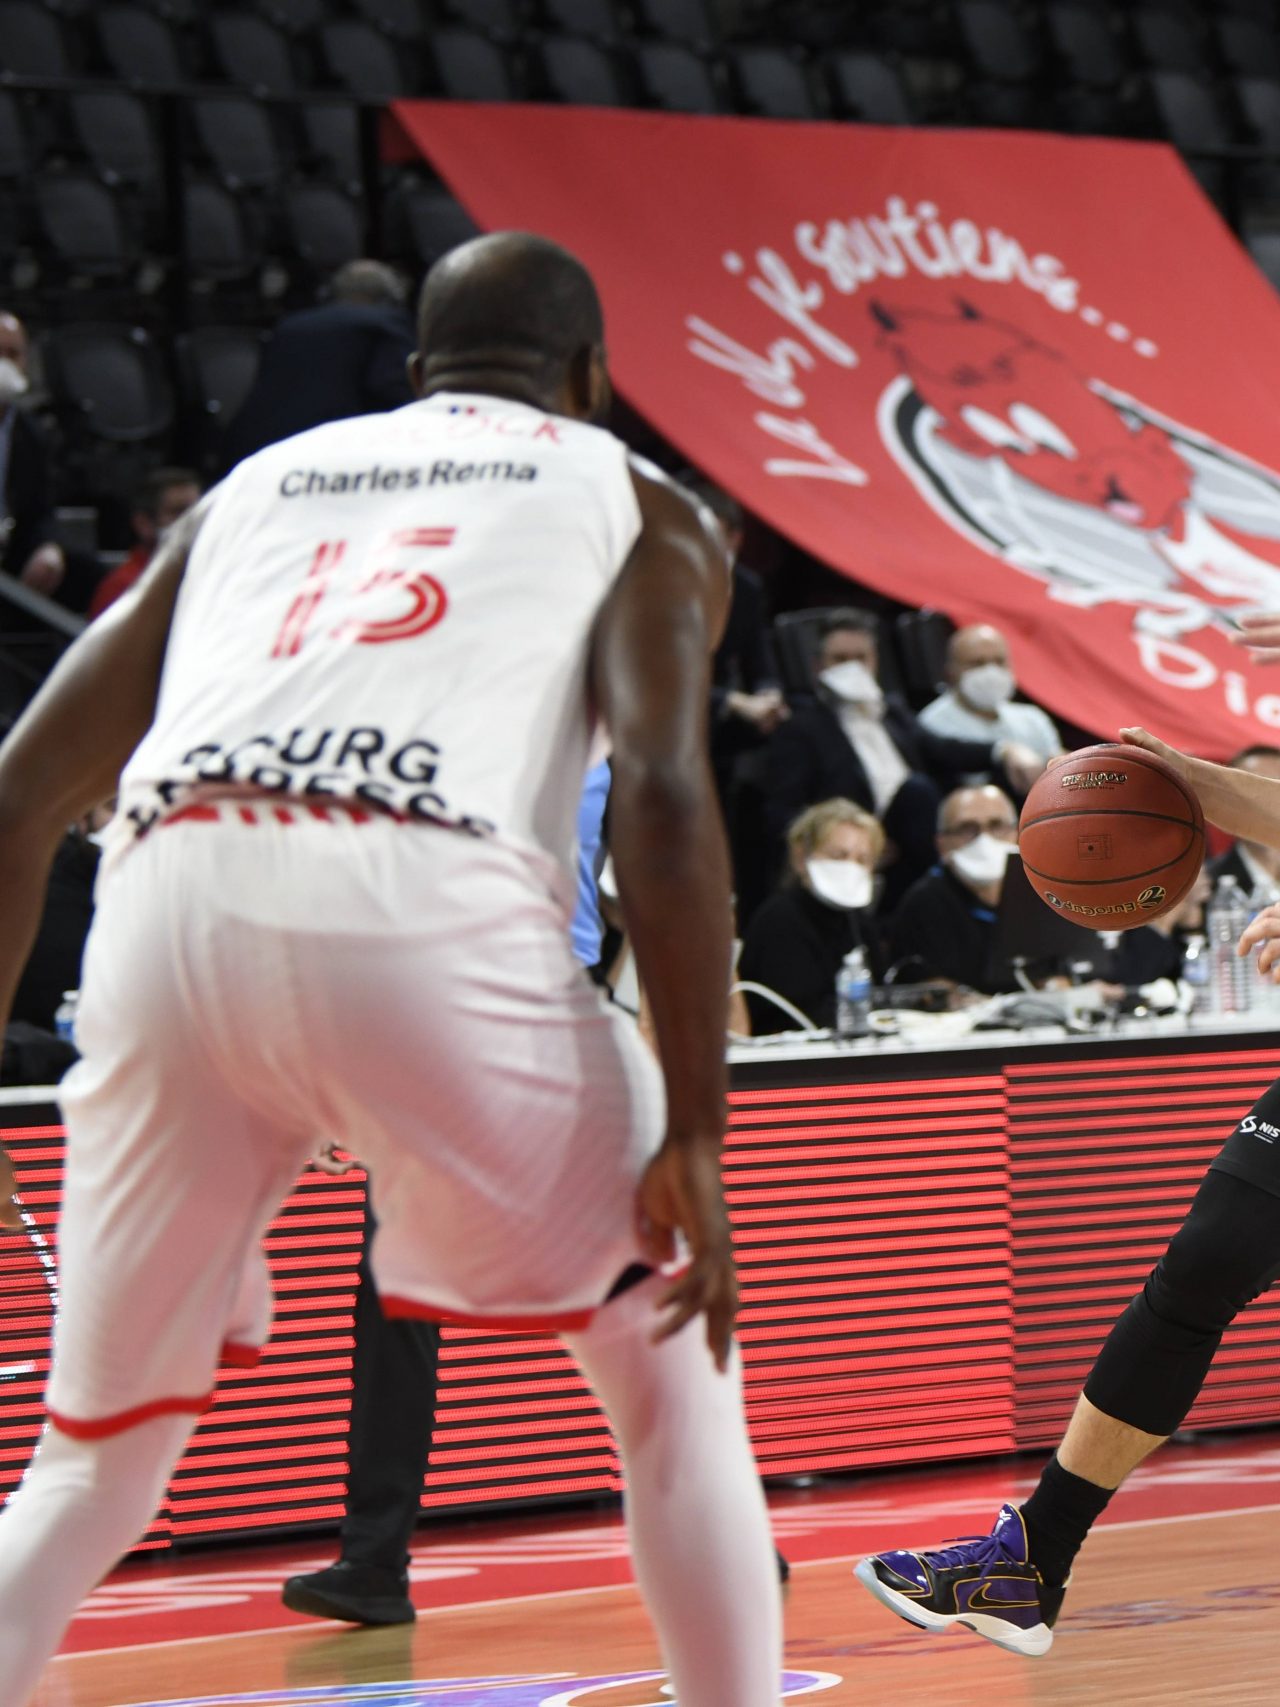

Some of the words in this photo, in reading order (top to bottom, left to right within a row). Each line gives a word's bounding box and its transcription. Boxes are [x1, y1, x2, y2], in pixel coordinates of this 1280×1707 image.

[279, 464, 422, 498] Charles
[270, 525, 457, 660] 15
[1258, 1122, 1280, 1138] NIS
